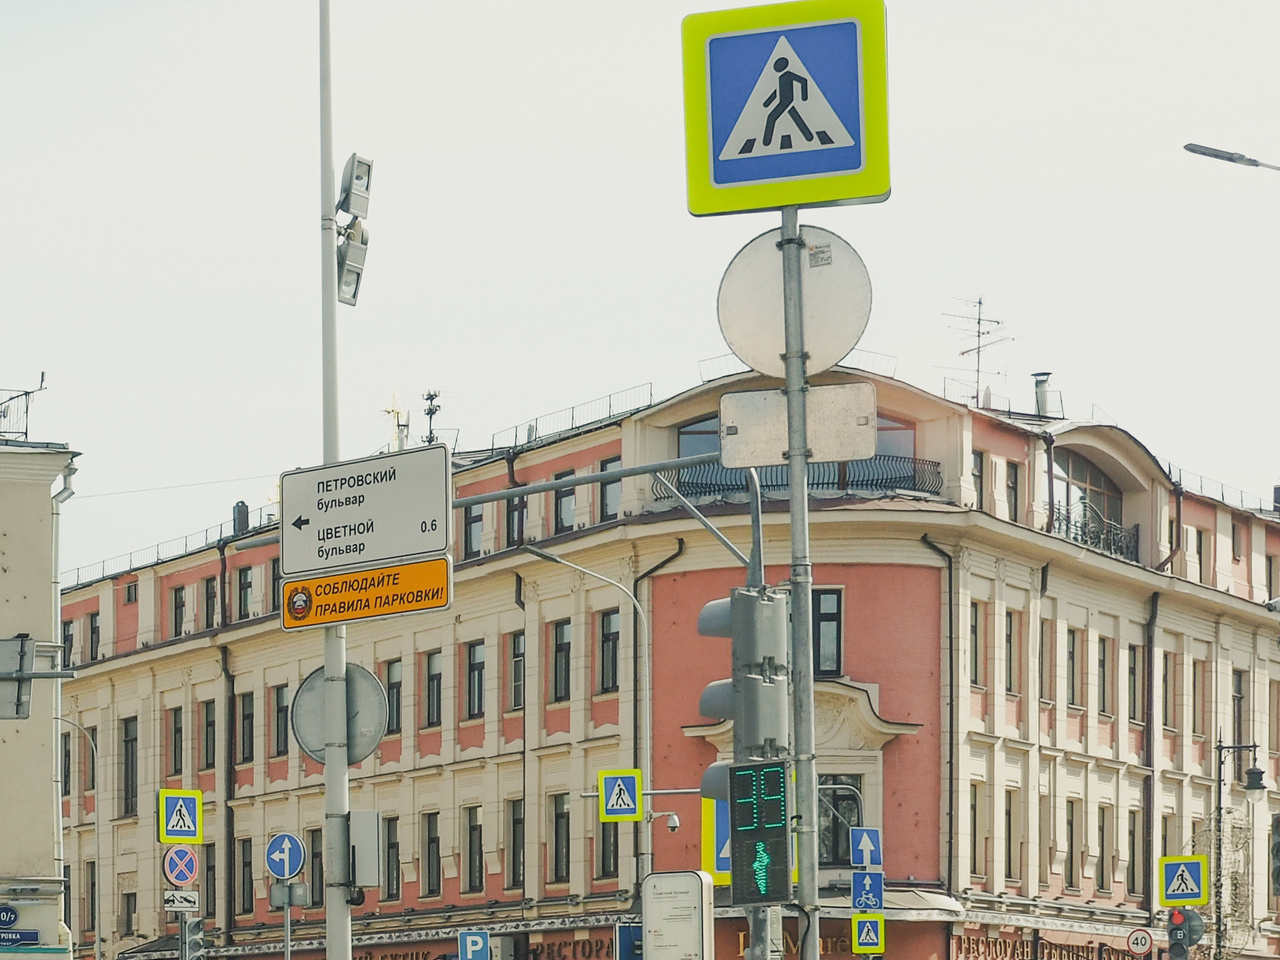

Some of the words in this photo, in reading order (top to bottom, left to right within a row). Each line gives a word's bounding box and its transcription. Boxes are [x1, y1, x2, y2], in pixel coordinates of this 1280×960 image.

[317, 467, 396, 493] ПЕТРОВСКИЙ
[317, 494, 365, 512] бульвар
[317, 518, 374, 542] ЦВЕТНОЙ
[420, 519, 438, 533] 0.6
[317, 542, 365, 561] бульвар
[315, 573, 400, 597] СОБЛЮДАЙТЕ
[315, 598, 370, 617] ПРАВИЛА
[373, 588, 444, 609] ПАРКОВКИ!
[466, 935, 483, 960] P
[536, 938, 613, 960] РЕСТОРА
[960, 935, 1032, 960] РЕСТОРАН
[1132, 936, 1147, 947] 40
